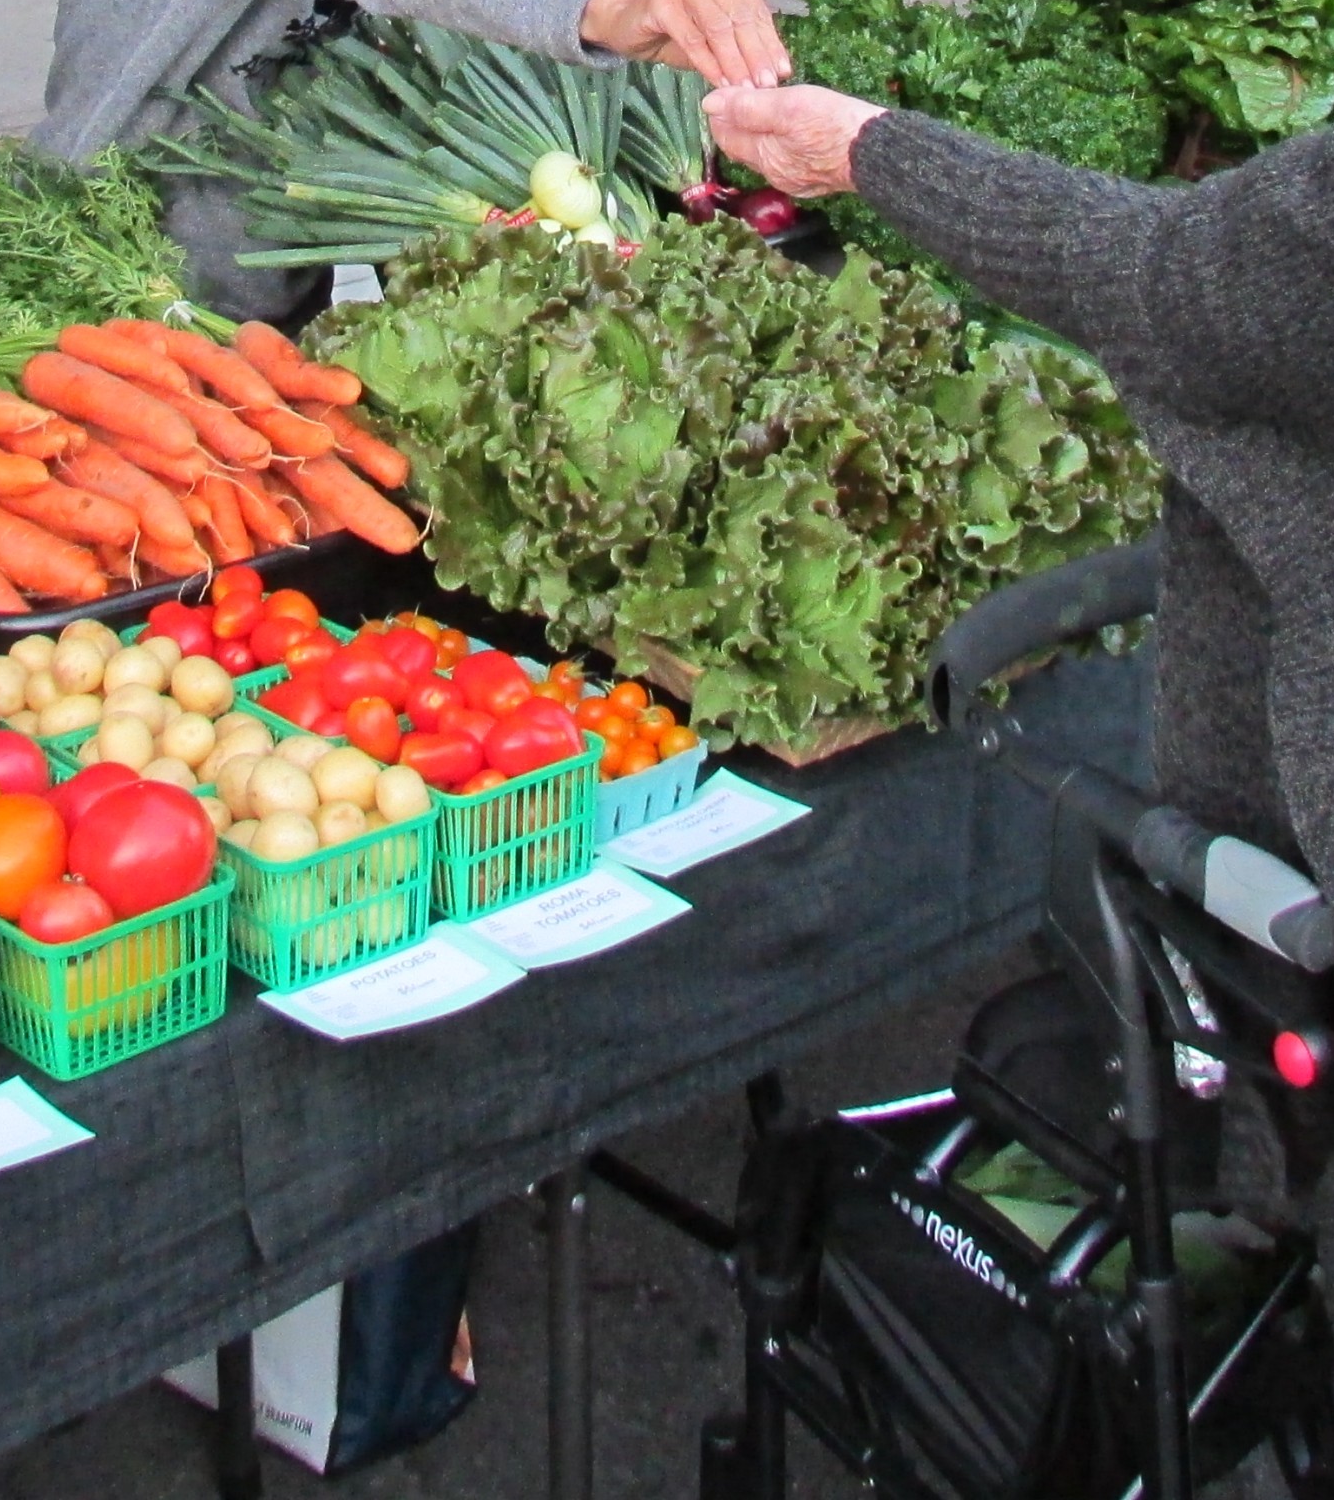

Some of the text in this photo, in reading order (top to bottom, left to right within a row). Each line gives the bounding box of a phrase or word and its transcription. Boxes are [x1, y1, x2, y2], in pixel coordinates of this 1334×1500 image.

[533, 888, 623, 931] TOMATOES
[537, 886, 590, 913] ROMA
[349, 949, 437, 991] POTATOES
[266, 1409, 314, 1437] BRAMPTON
